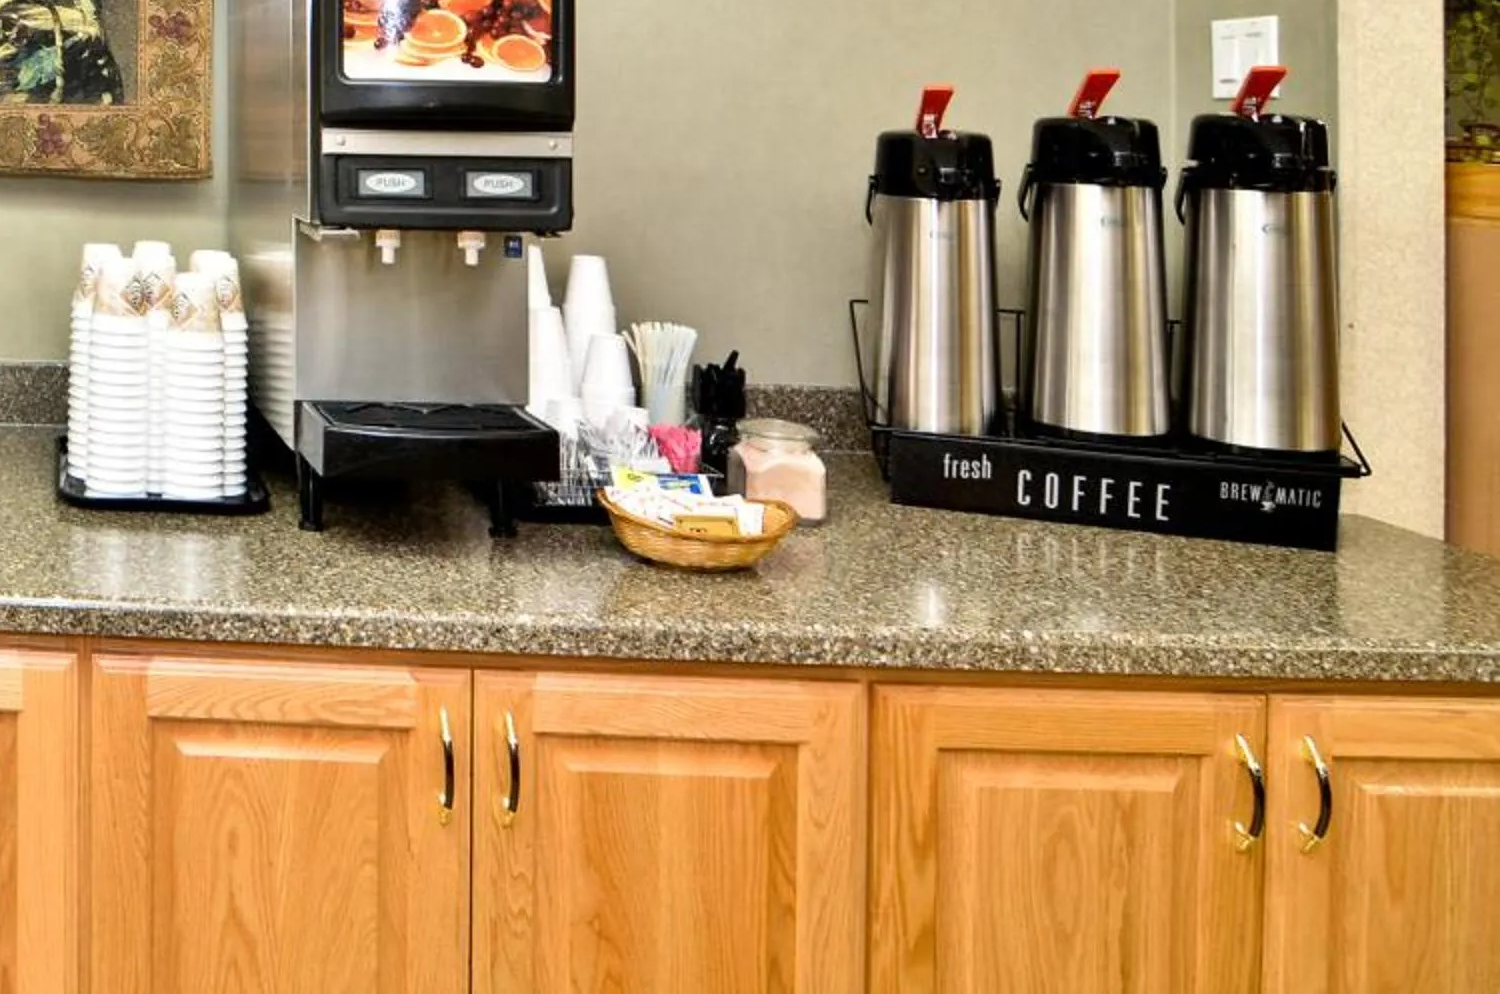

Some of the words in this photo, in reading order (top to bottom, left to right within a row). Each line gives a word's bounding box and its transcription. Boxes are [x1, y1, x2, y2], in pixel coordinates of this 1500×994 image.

[376, 177, 406, 189] PUSH
[484, 178, 514, 190] PUSH
[943, 453, 993, 480] fresh
[1017, 469, 1172, 522] COFFEE
